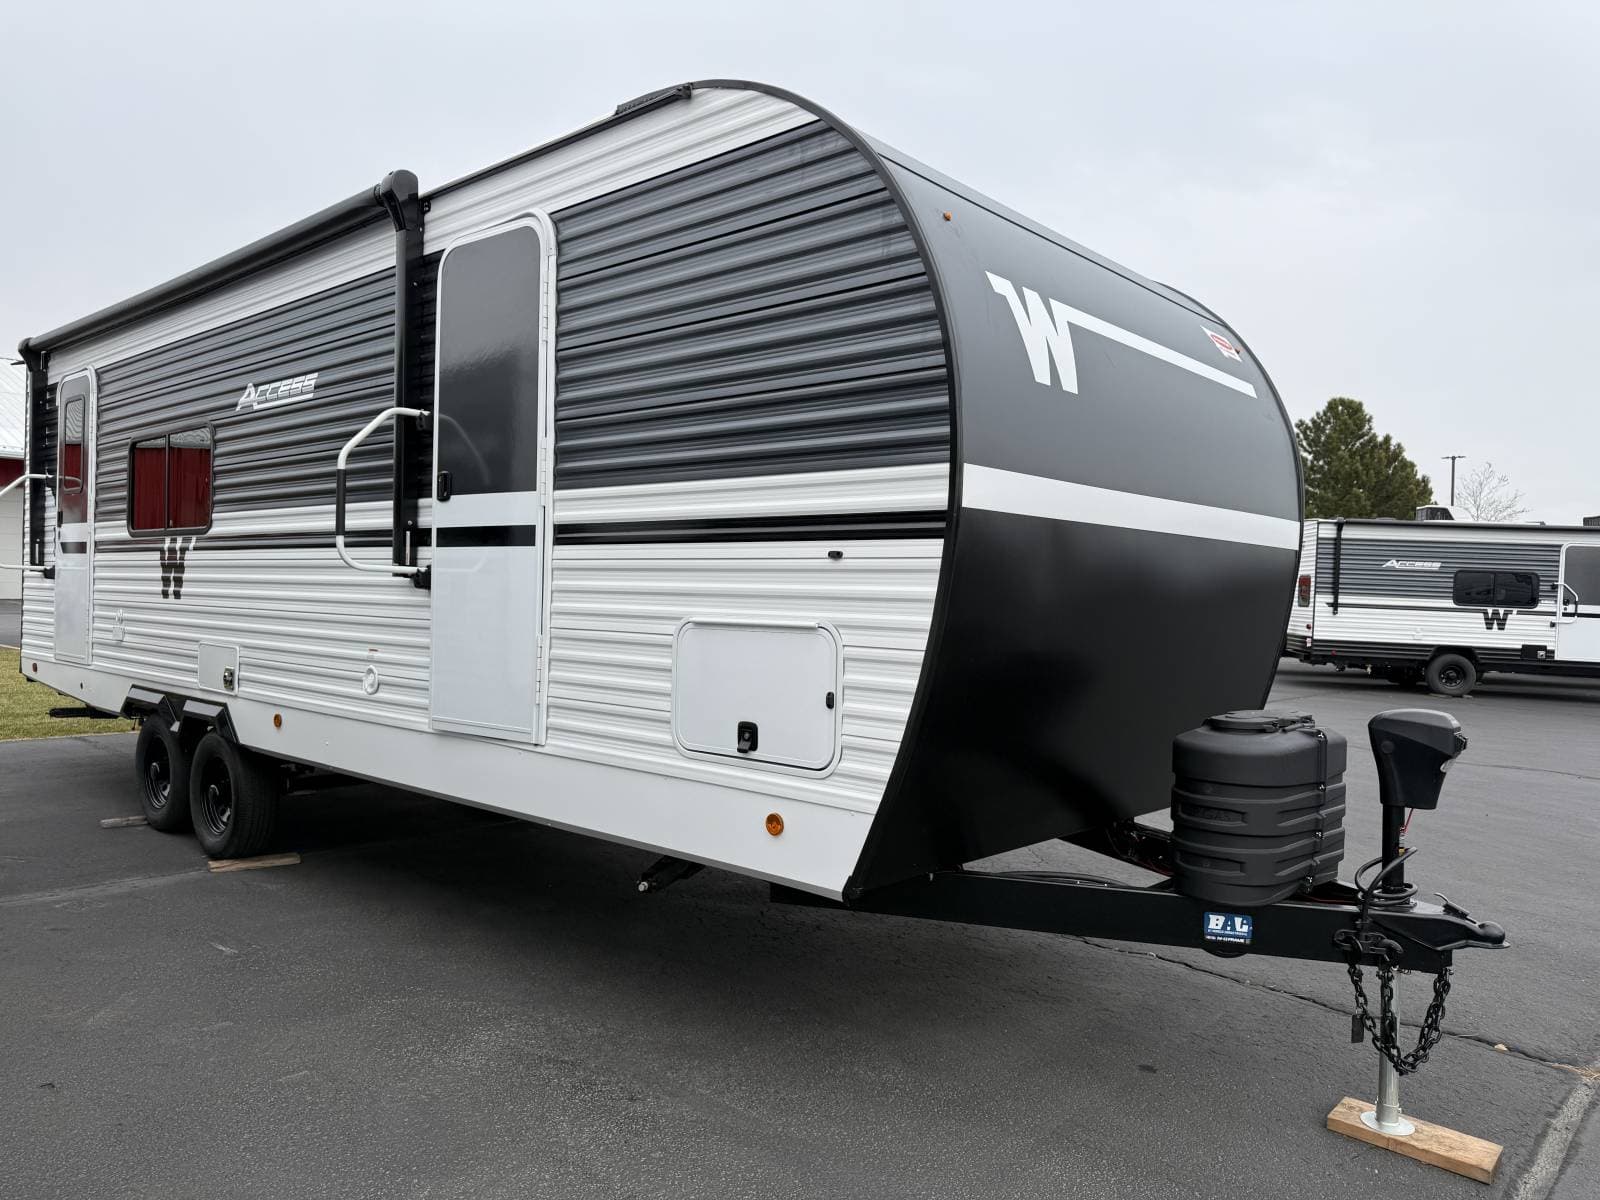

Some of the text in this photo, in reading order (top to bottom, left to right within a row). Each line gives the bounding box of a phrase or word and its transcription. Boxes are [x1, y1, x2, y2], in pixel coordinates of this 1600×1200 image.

[235, 372, 319, 412] ACCESS
[159, 535, 192, 600] W
[1482, 608, 1514, 631] W
